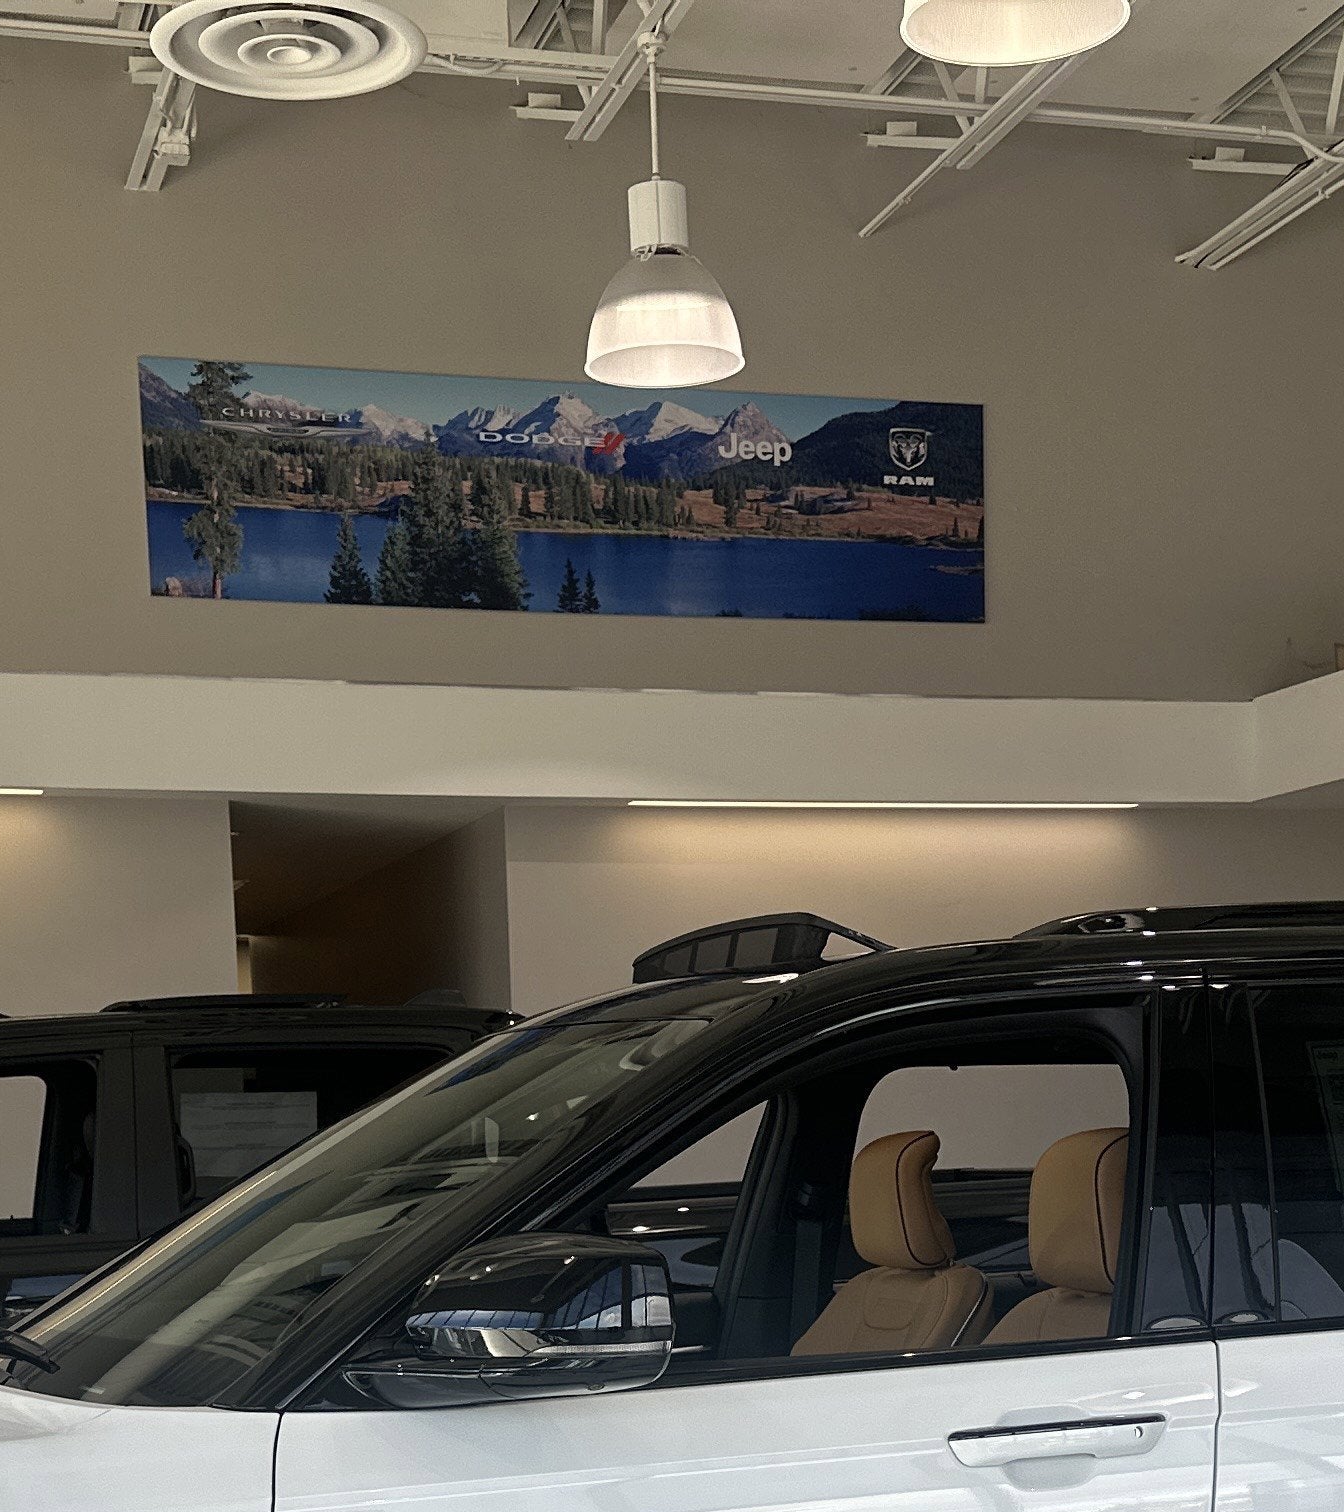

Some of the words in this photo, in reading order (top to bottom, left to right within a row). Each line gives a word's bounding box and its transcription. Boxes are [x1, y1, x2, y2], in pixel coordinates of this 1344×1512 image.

[221, 407, 352, 423] CHRYSLER
[479, 431, 607, 448] DODGE
[717, 432, 793, 467] Jeep
[883, 475, 935, 486] RAM
